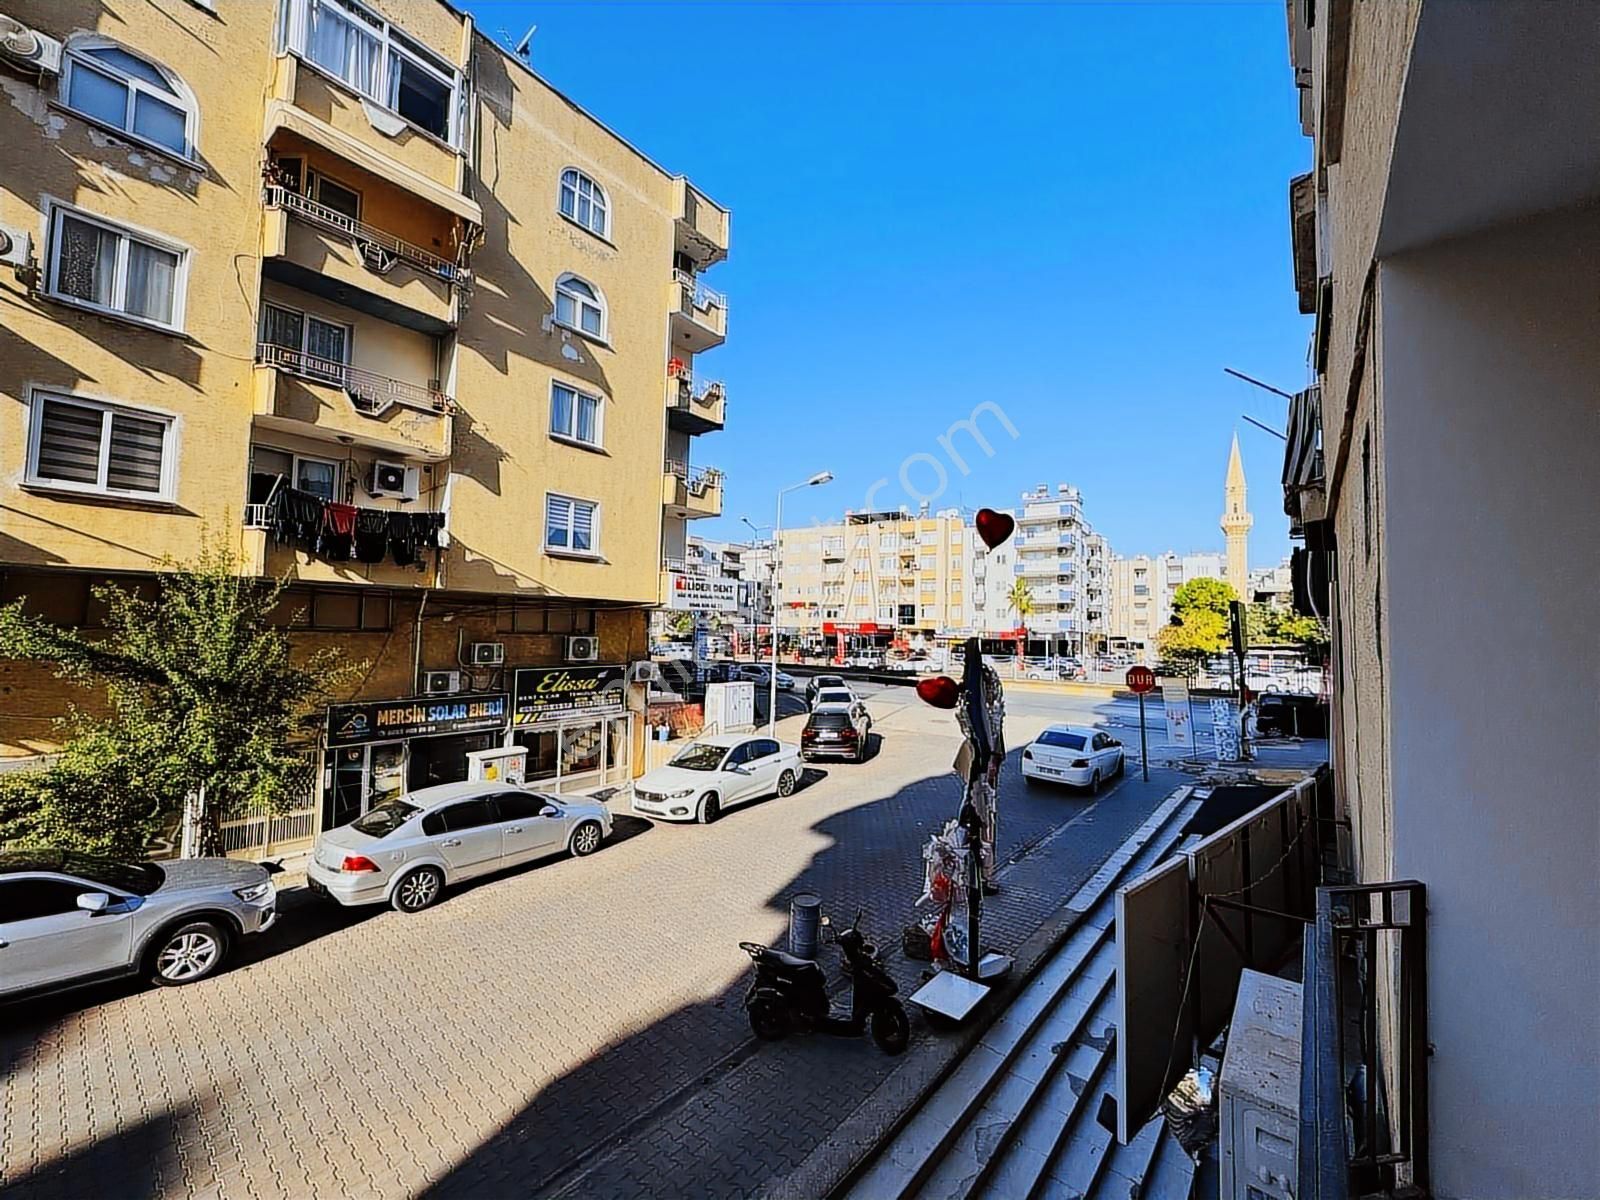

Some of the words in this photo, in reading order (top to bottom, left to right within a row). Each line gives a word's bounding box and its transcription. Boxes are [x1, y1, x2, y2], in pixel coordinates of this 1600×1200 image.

[713, 583, 733, 593] DENT
[536, 671, 600, 693] Elissa
[1127, 674, 1154, 686] DUR
[377, 704, 426, 727] MERSİN
[427, 704, 467, 722] SOLAR
